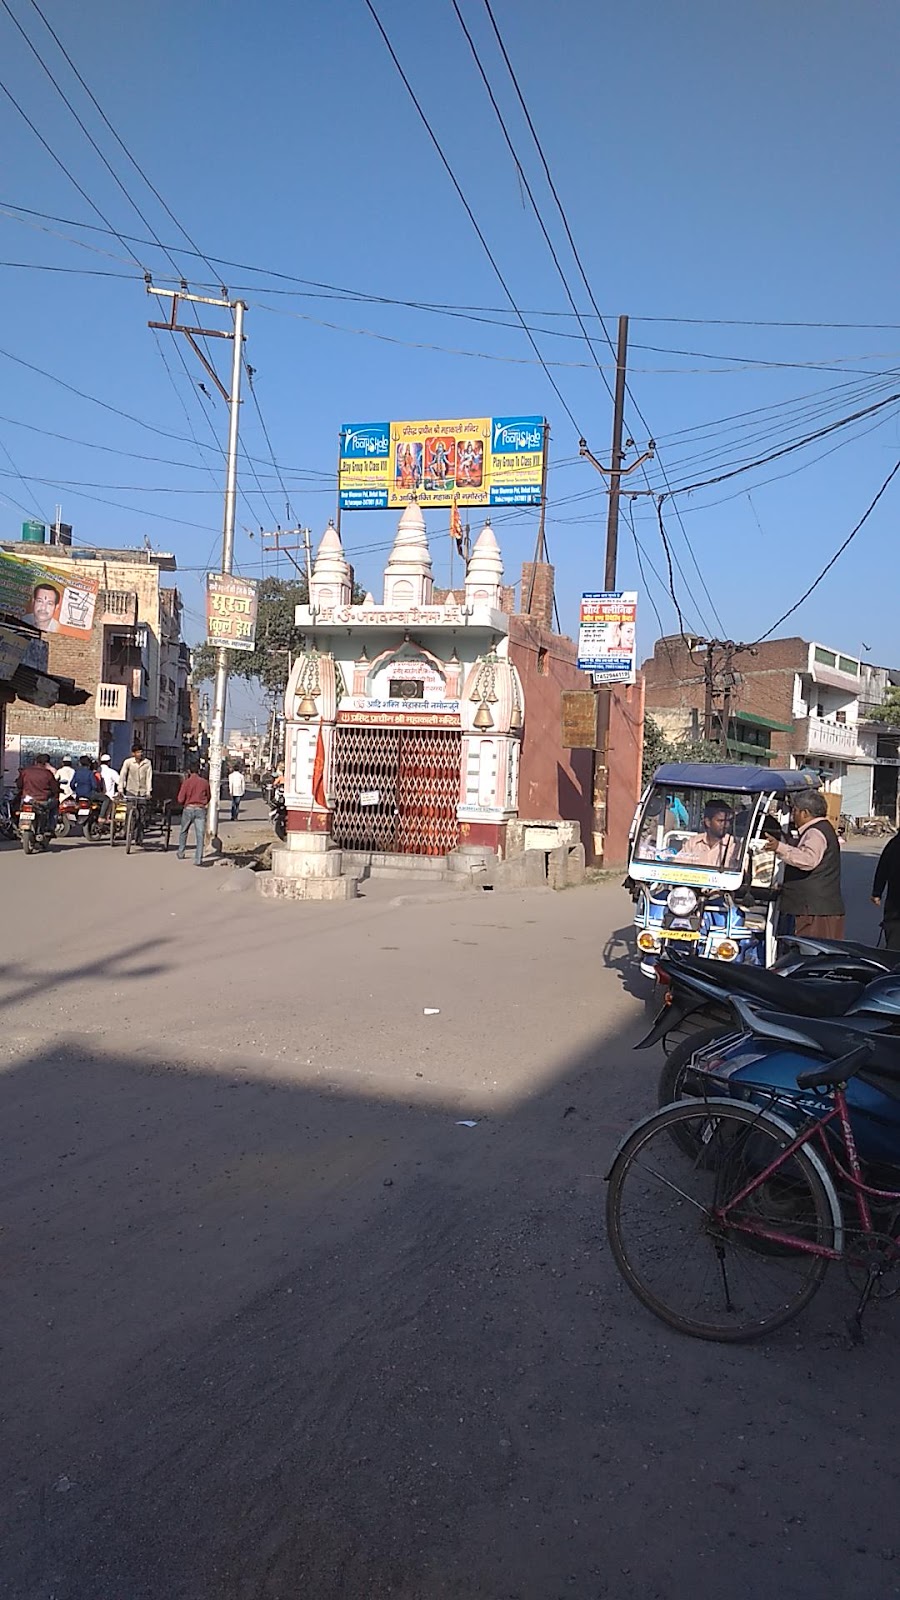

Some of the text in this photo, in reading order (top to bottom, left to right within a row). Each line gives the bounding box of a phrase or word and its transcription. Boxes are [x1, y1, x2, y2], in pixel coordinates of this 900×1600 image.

[352, 461, 363, 474] Group
[369, 460, 379, 471] Class
[493, 457, 501, 470] Play
[503, 456, 514, 469] Group
[516, 456, 519, 466] To
[521, 456, 531, 466] Class
[211, 593, 252, 616] सूरज
[395, 714, 405, 723] श्री
[406, 714, 438, 724] महाकाली
